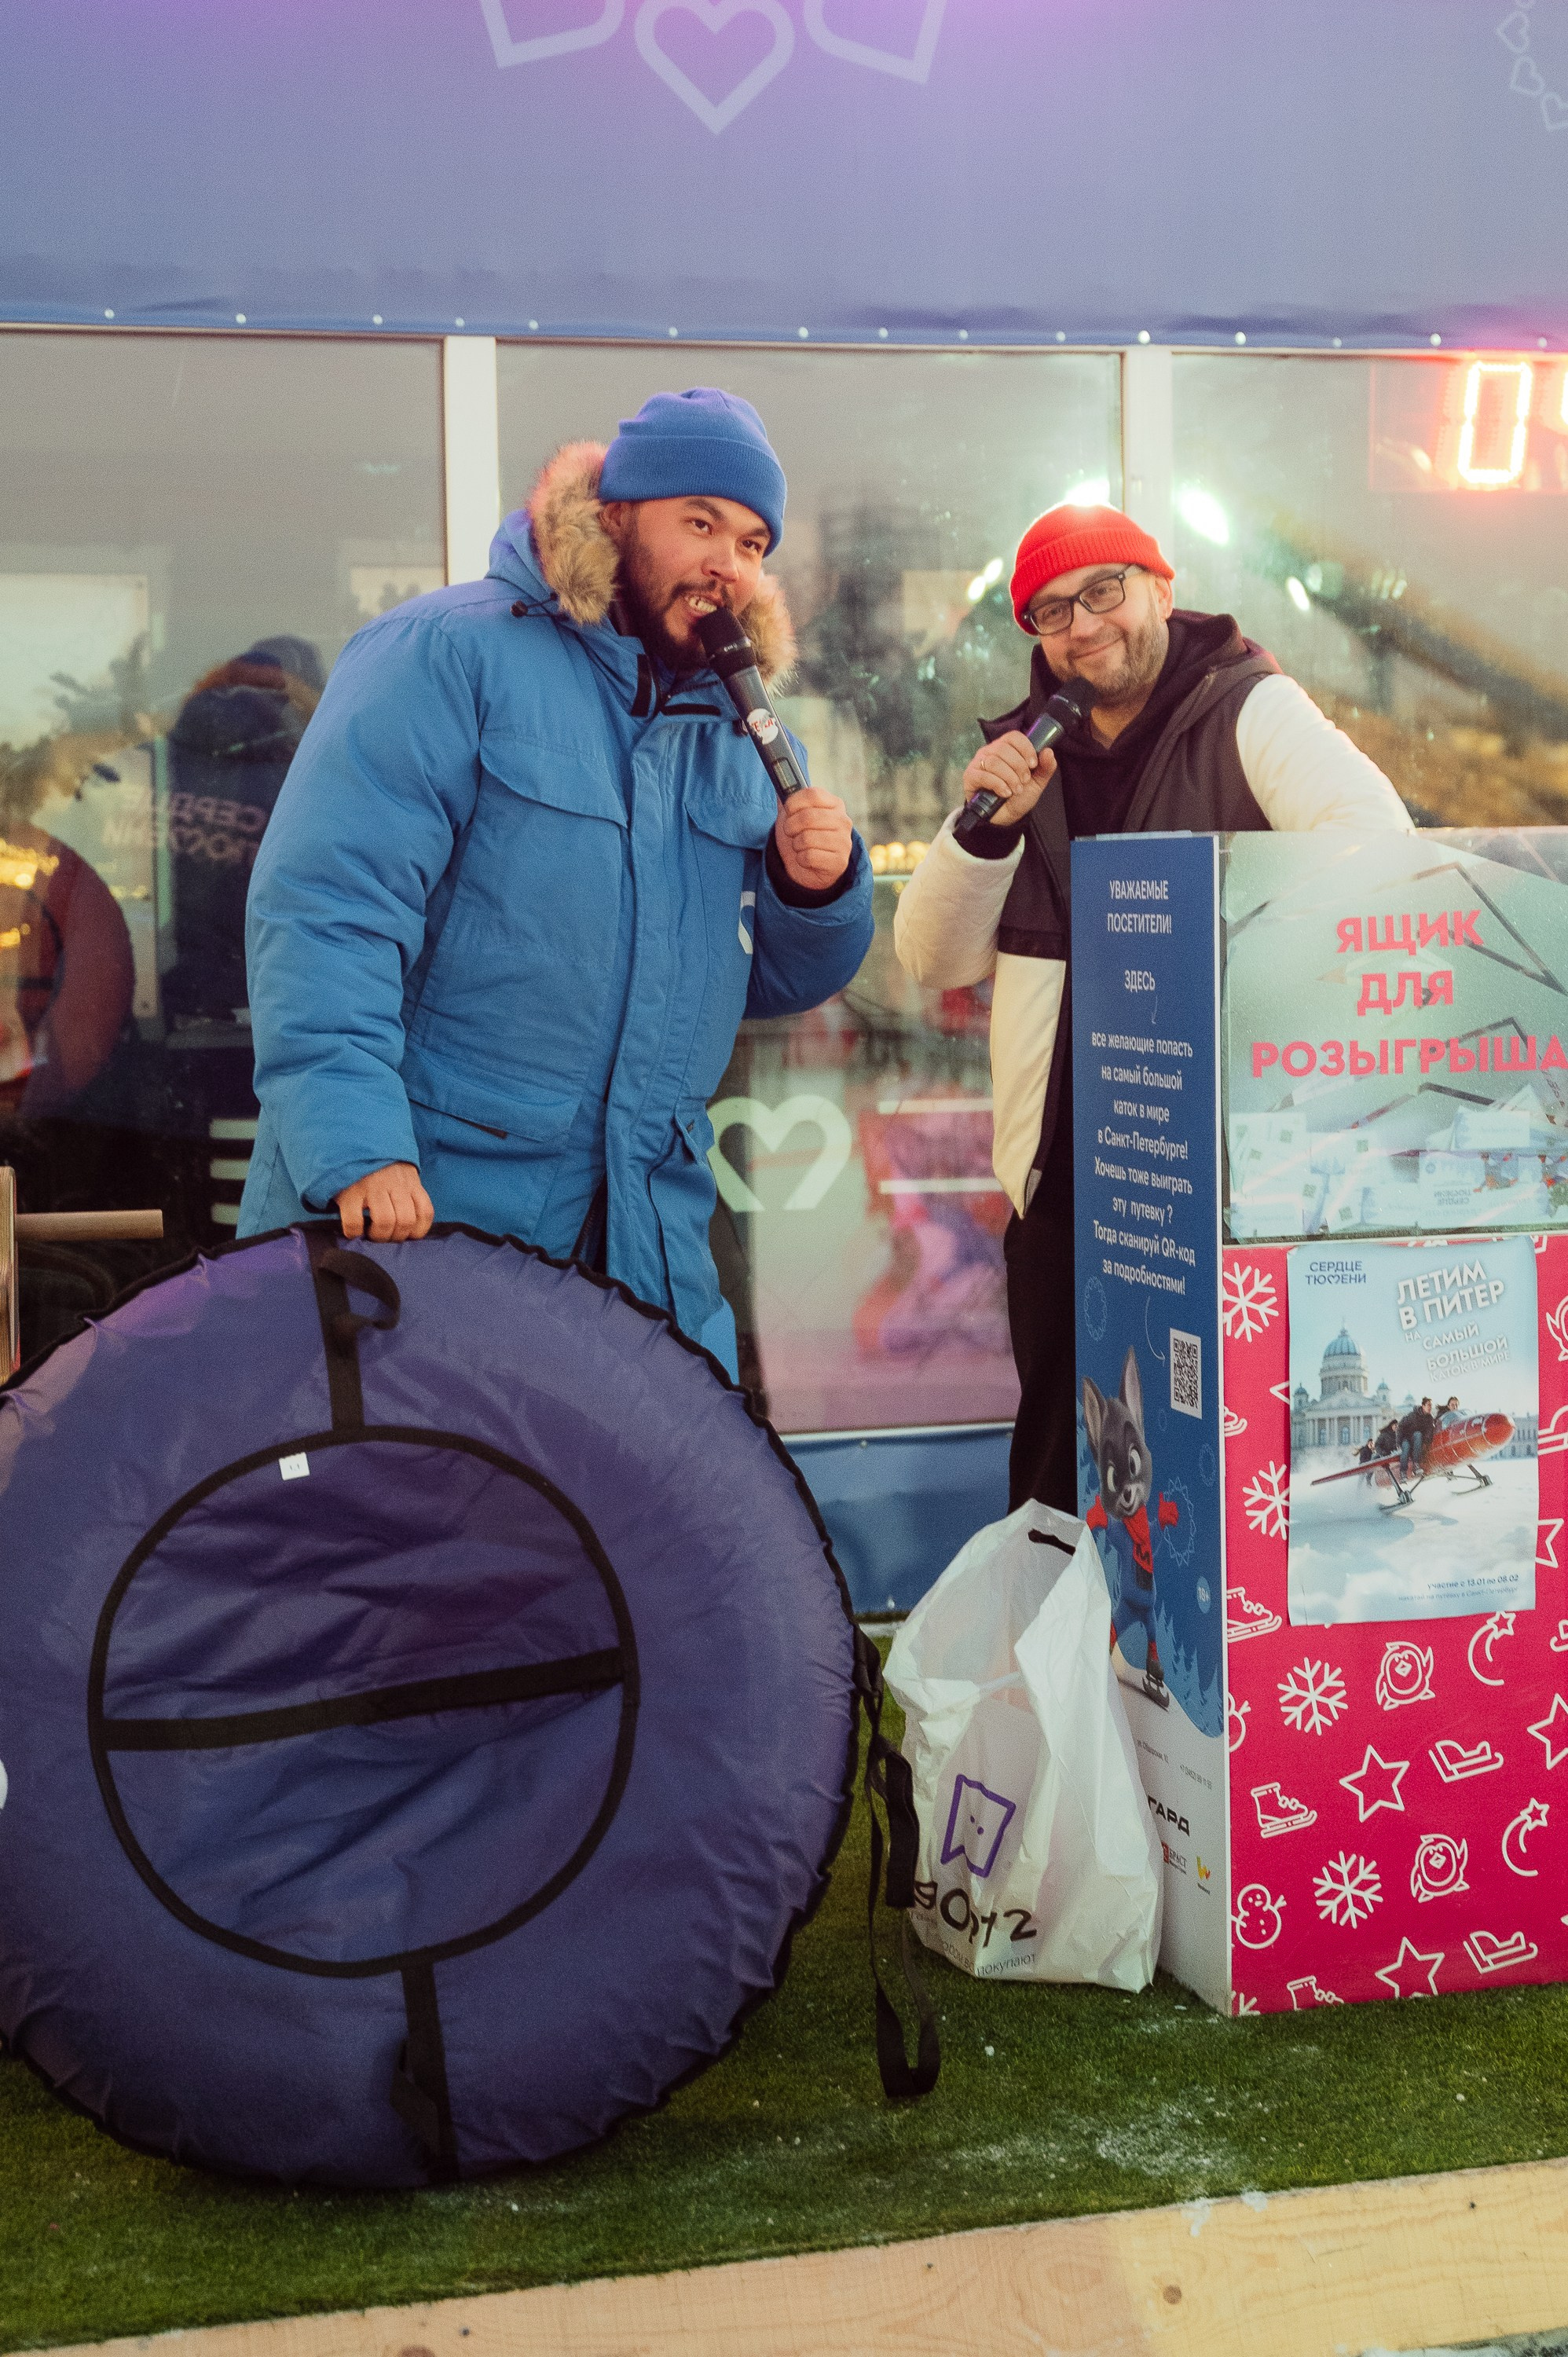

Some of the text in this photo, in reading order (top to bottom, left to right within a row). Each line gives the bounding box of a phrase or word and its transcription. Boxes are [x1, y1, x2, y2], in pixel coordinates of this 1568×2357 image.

[1109, 879, 1169, 900] УВАЖАЕМЫЕ
[1107, 912, 1172, 934] ПОСЕТИТЕЛИ!
[1336, 909, 1485, 955] ЯЩИК
[1124, 970, 1156, 993] ЗДЕСЬ
[1357, 970, 1454, 1017] ДЛЯ
[1092, 1031, 1193, 1058] все желающие попасть
[1251, 1035, 1568, 1078] РОЗЫГРЫША
[1101, 1064, 1182, 1091] на самый большой
[1113, 1099, 1170, 1125] каток в мире
[1097, 1126, 1189, 1161] в Санкт-Петербурге!
[1094, 1156, 1193, 1195] Хочешь тоже выиграть
[1112, 1197, 1127, 1218] эту
[1130, 1200, 1165, 1226] путевку
[1094, 1219, 1196, 1266] Тогда сканируй QR-код
[1102, 1258, 1185, 1296] за подробностями!
[1310, 1260, 1362, 1273] СЕРДЦЕ
[1398, 1259, 1487, 1304] ЛЕТИМ
[1399, 1279, 1504, 1330] В ПИТЕР
[1405, 1321, 1479, 1351] НА САМЫЙ
[1427, 1335, 1508, 1370] БОЛЬШОЙ
[1430, 1351, 1510, 1382] КАТОК В МИРЕ
